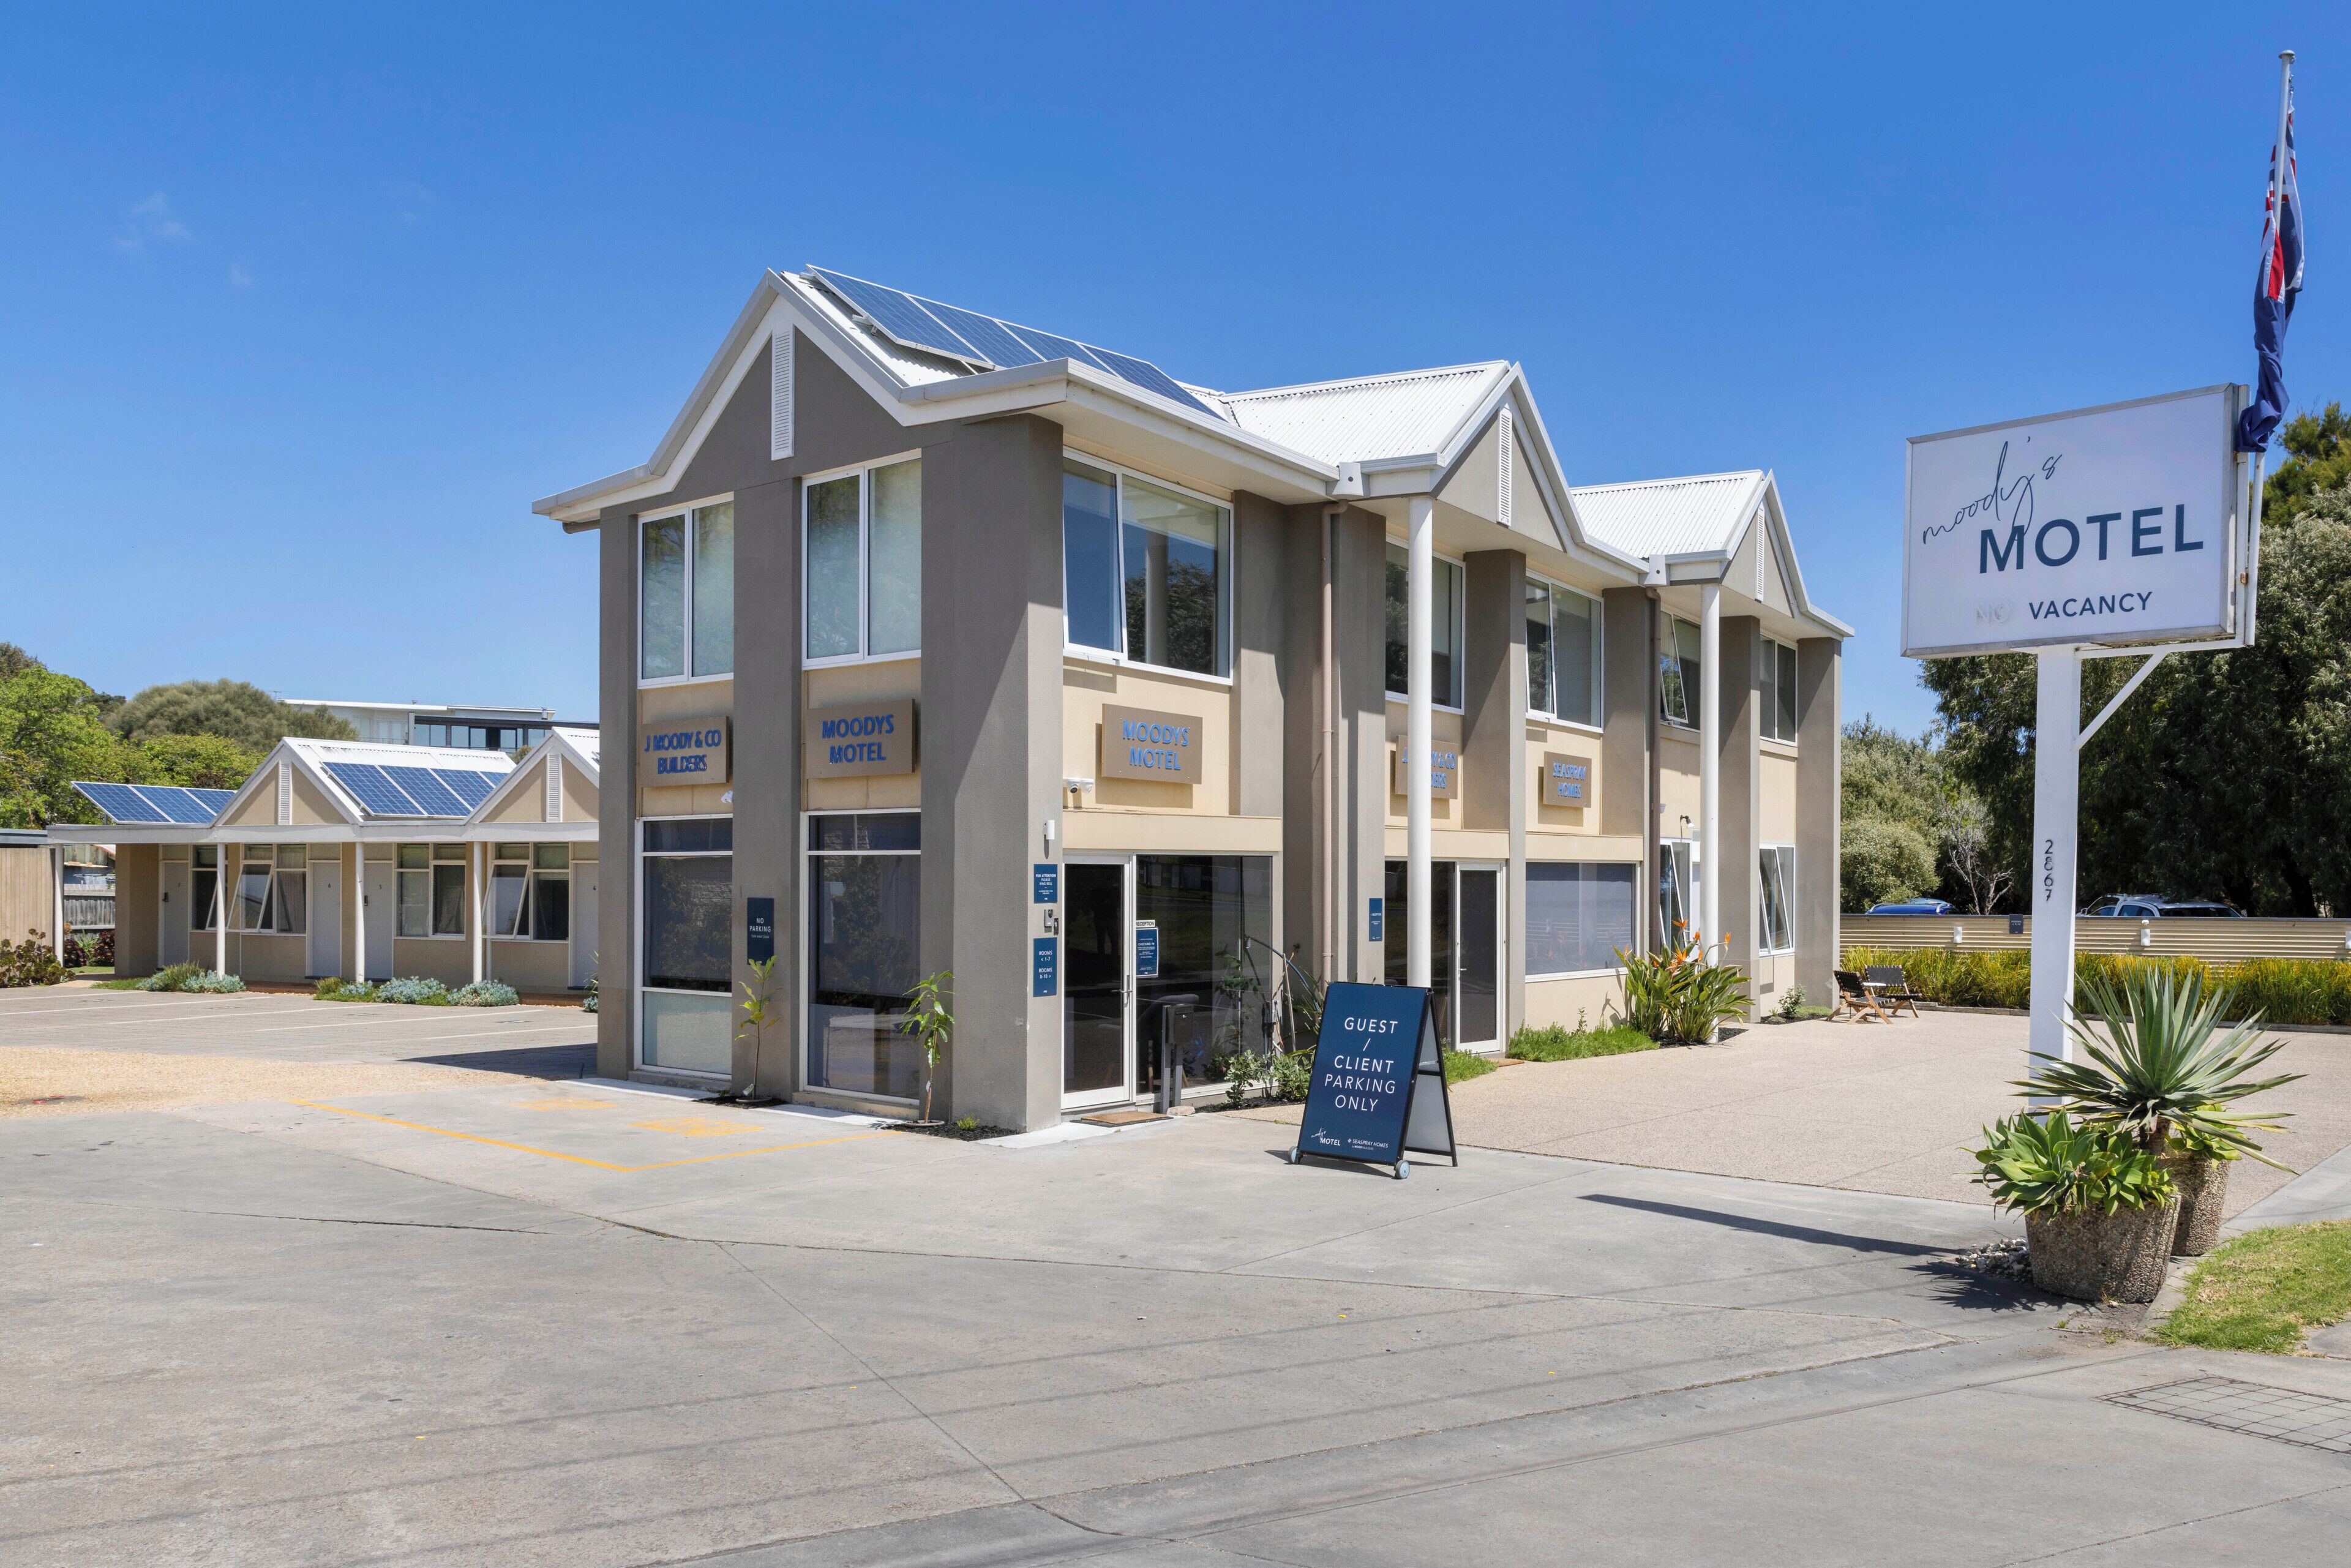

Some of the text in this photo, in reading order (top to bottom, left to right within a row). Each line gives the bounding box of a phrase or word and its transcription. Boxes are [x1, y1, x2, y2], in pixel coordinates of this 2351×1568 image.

[1922, 437, 2063, 544] moody's
[1979, 504, 2203, 574] MOTEL
[2029, 591, 2153, 620] VACANCY
[822, 714, 894, 739] MOODYS
[1123, 719, 1189, 746] MOODYS
[644, 728, 721, 752] J MOODY & CO
[830, 742, 886, 763] MOTEL
[1130, 746, 1182, 770] MOTEL
[1445, 752, 1456, 769] CO
[658, 754, 707, 775] BUILDERS
[1553, 762, 1586, 781] SEASPRAY
[1558, 782, 1581, 798] HOMES
[2044, 839, 2053, 902] 2867
[1344, 1017, 1398, 1033] GUEST
[1334, 1055, 1394, 1073] CLIENT
[1325, 1074, 1395, 1093] PARKING
[1335, 1095, 1378, 1112] ONLY
